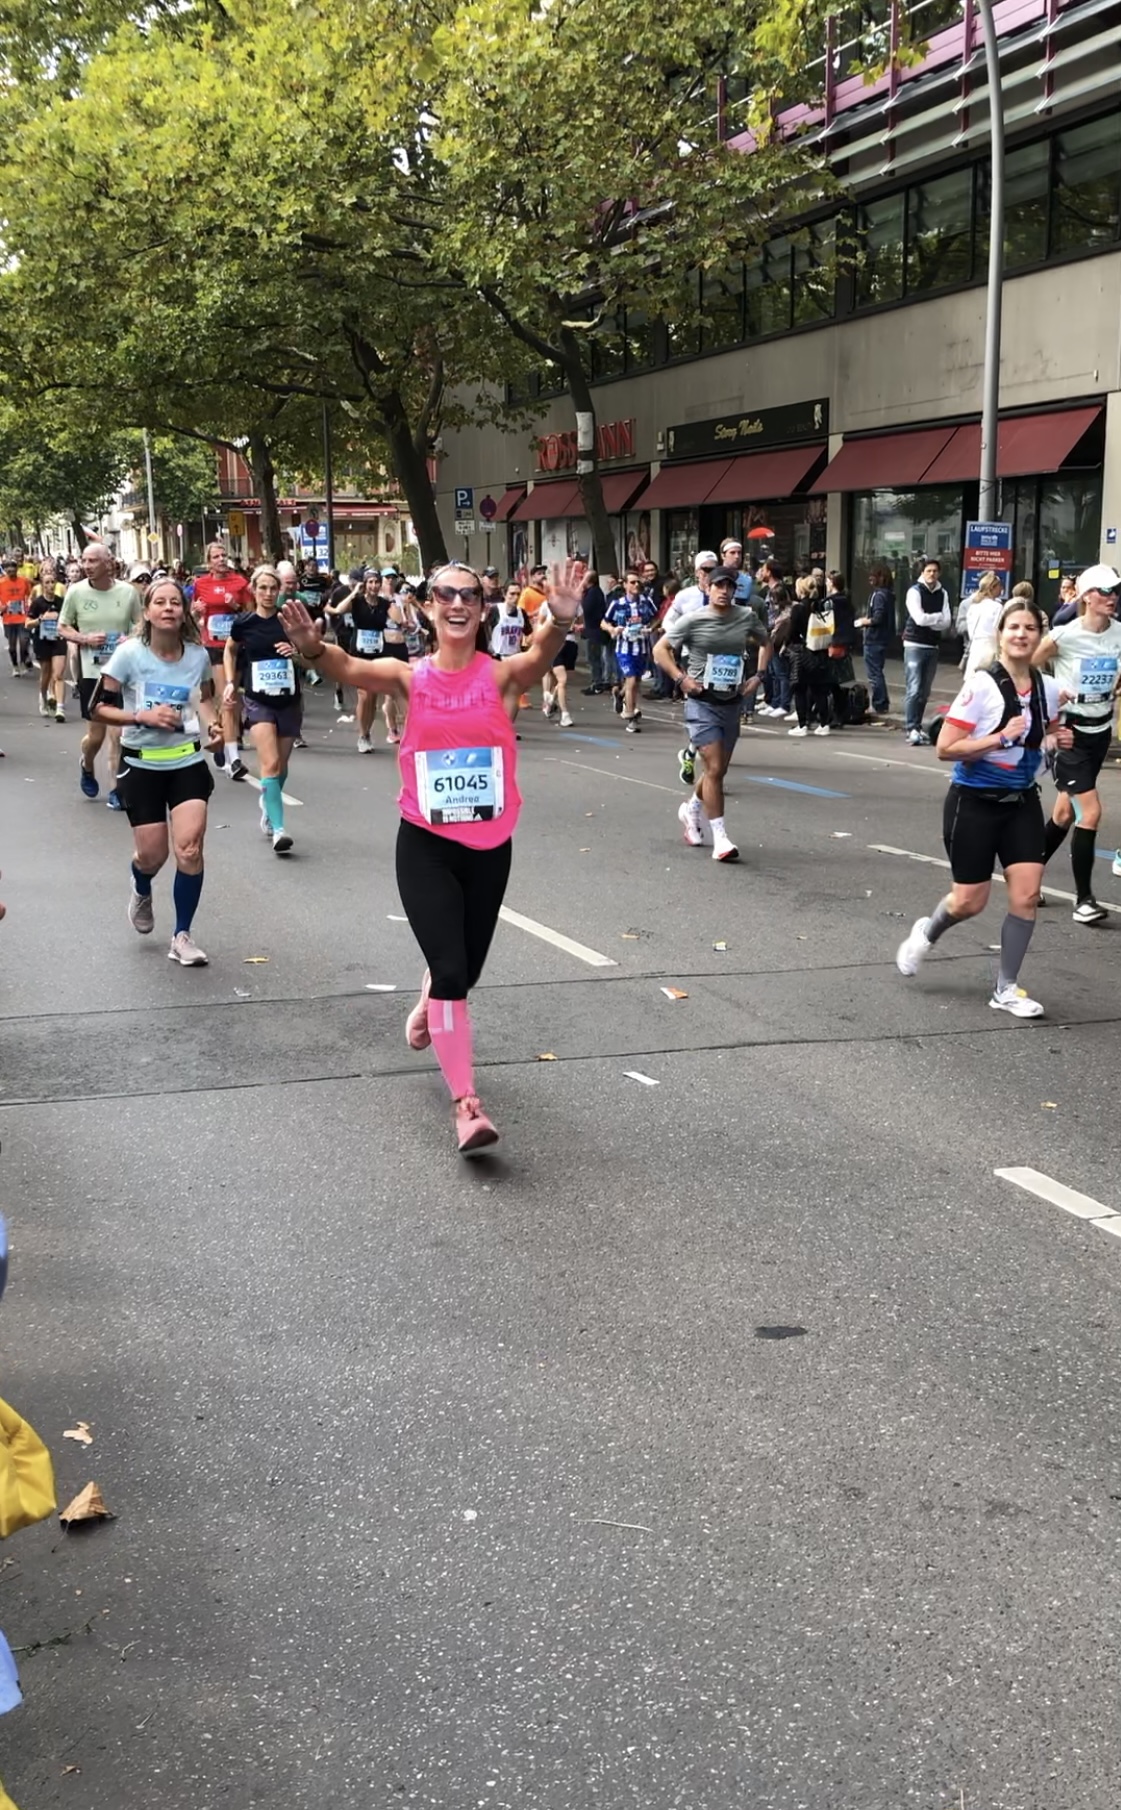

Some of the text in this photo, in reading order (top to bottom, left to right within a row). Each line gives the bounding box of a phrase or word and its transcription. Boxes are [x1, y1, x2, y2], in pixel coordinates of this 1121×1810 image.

[537, 419, 636, 471] ROSSANN
[457, 490, 469, 507] P
[433, 774, 489, 793] 61045
[445, 795, 480, 804] Andrea
